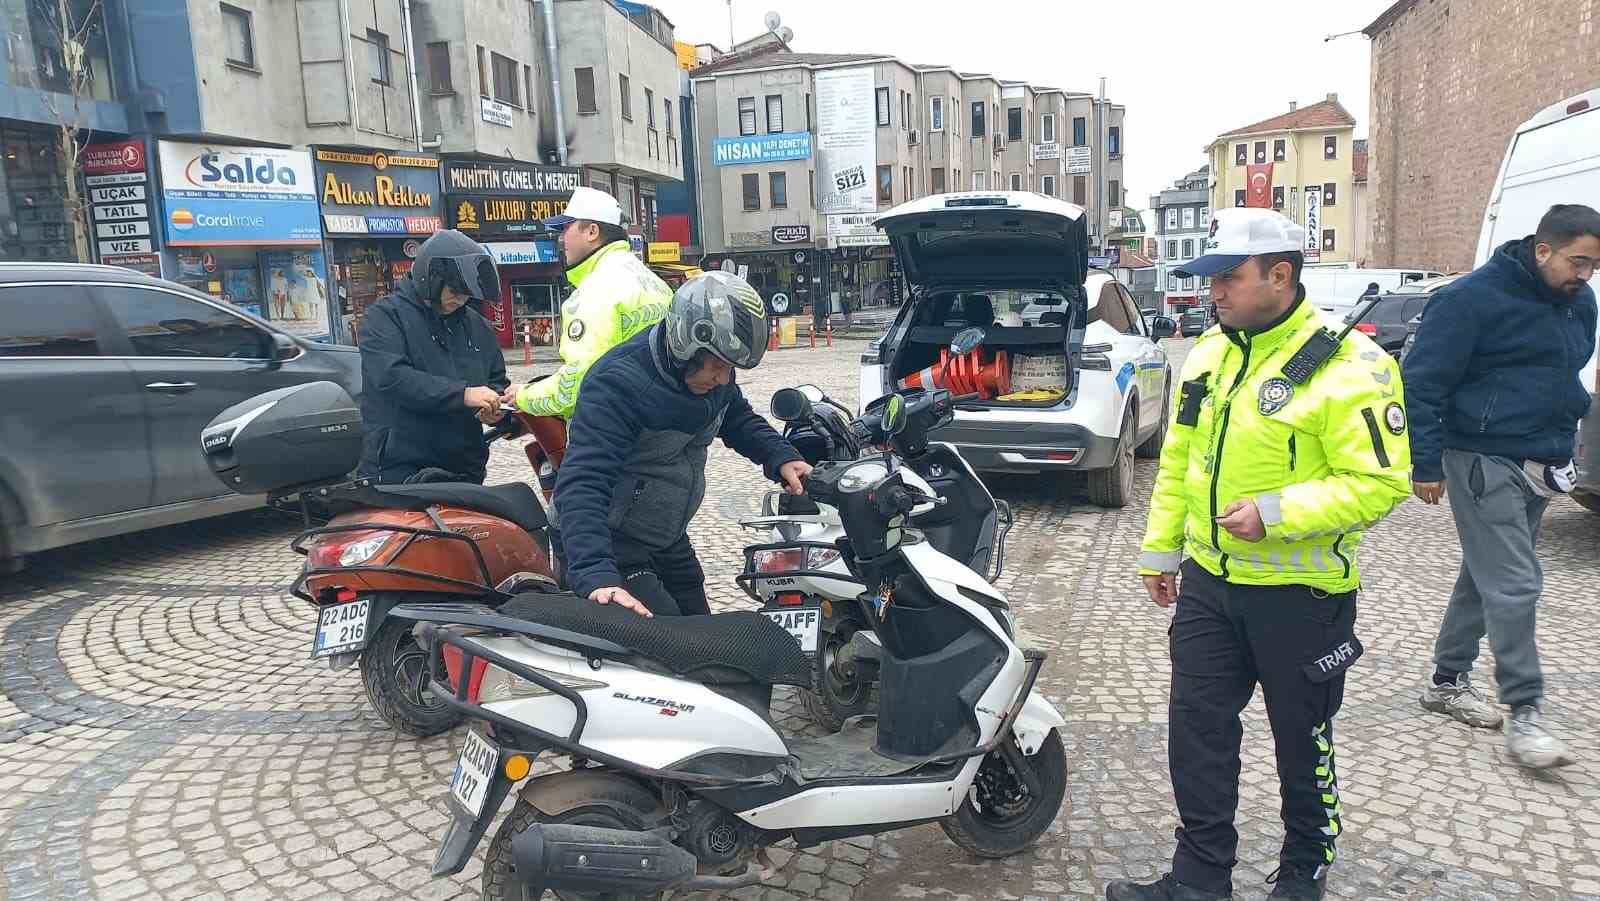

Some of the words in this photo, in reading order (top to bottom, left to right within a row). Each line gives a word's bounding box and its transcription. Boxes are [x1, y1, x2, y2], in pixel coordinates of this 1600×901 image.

[717, 140, 762, 161] NİSAN
[200, 153, 297, 186] Salda
[450, 164, 501, 189] MUHİTTİN
[502, 168, 534, 189] GÜNEL
[534, 167, 544, 192] İŞ
[545, 168, 582, 191] MERKEZİ
[836, 169, 867, 191] SİZİ
[99, 187, 138, 200] UÇAK
[484, 200, 526, 221] LUXURY
[531, 201, 551, 221] SPA
[109, 223, 137, 235] TUR
[110, 241, 141, 252] VİZE
[500, 251, 536, 263] kitabevi
[205, 436, 228, 448] SHAD
[322, 609, 339, 627] 22
[340, 602, 368, 622] ADC
[339, 623, 364, 643] 216
[459, 771, 478, 802] 127
